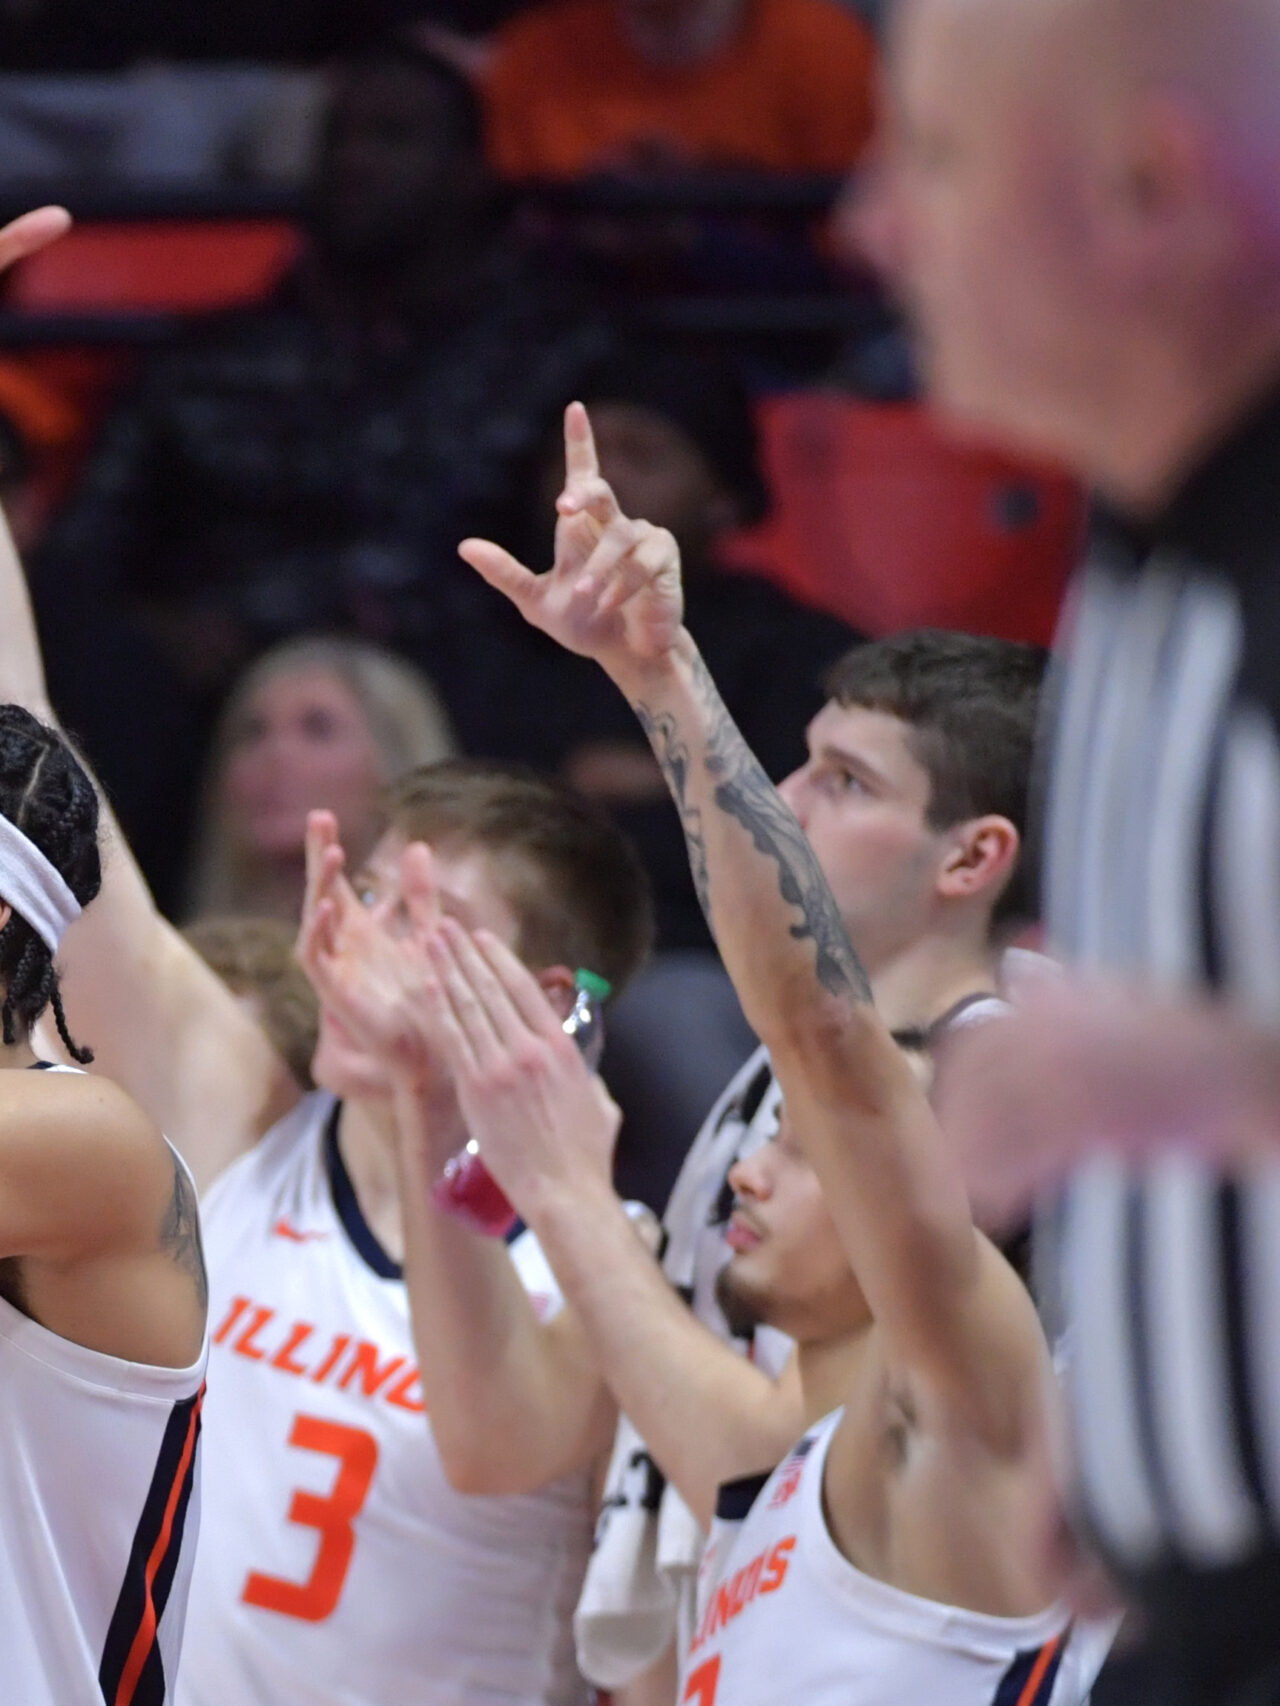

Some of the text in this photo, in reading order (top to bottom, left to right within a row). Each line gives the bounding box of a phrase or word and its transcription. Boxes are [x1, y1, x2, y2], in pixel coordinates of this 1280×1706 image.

[213, 1296, 428, 1414] ILLINO
[241, 1414, 380, 1626] 3
[687, 1533, 798, 1656] INOIS
